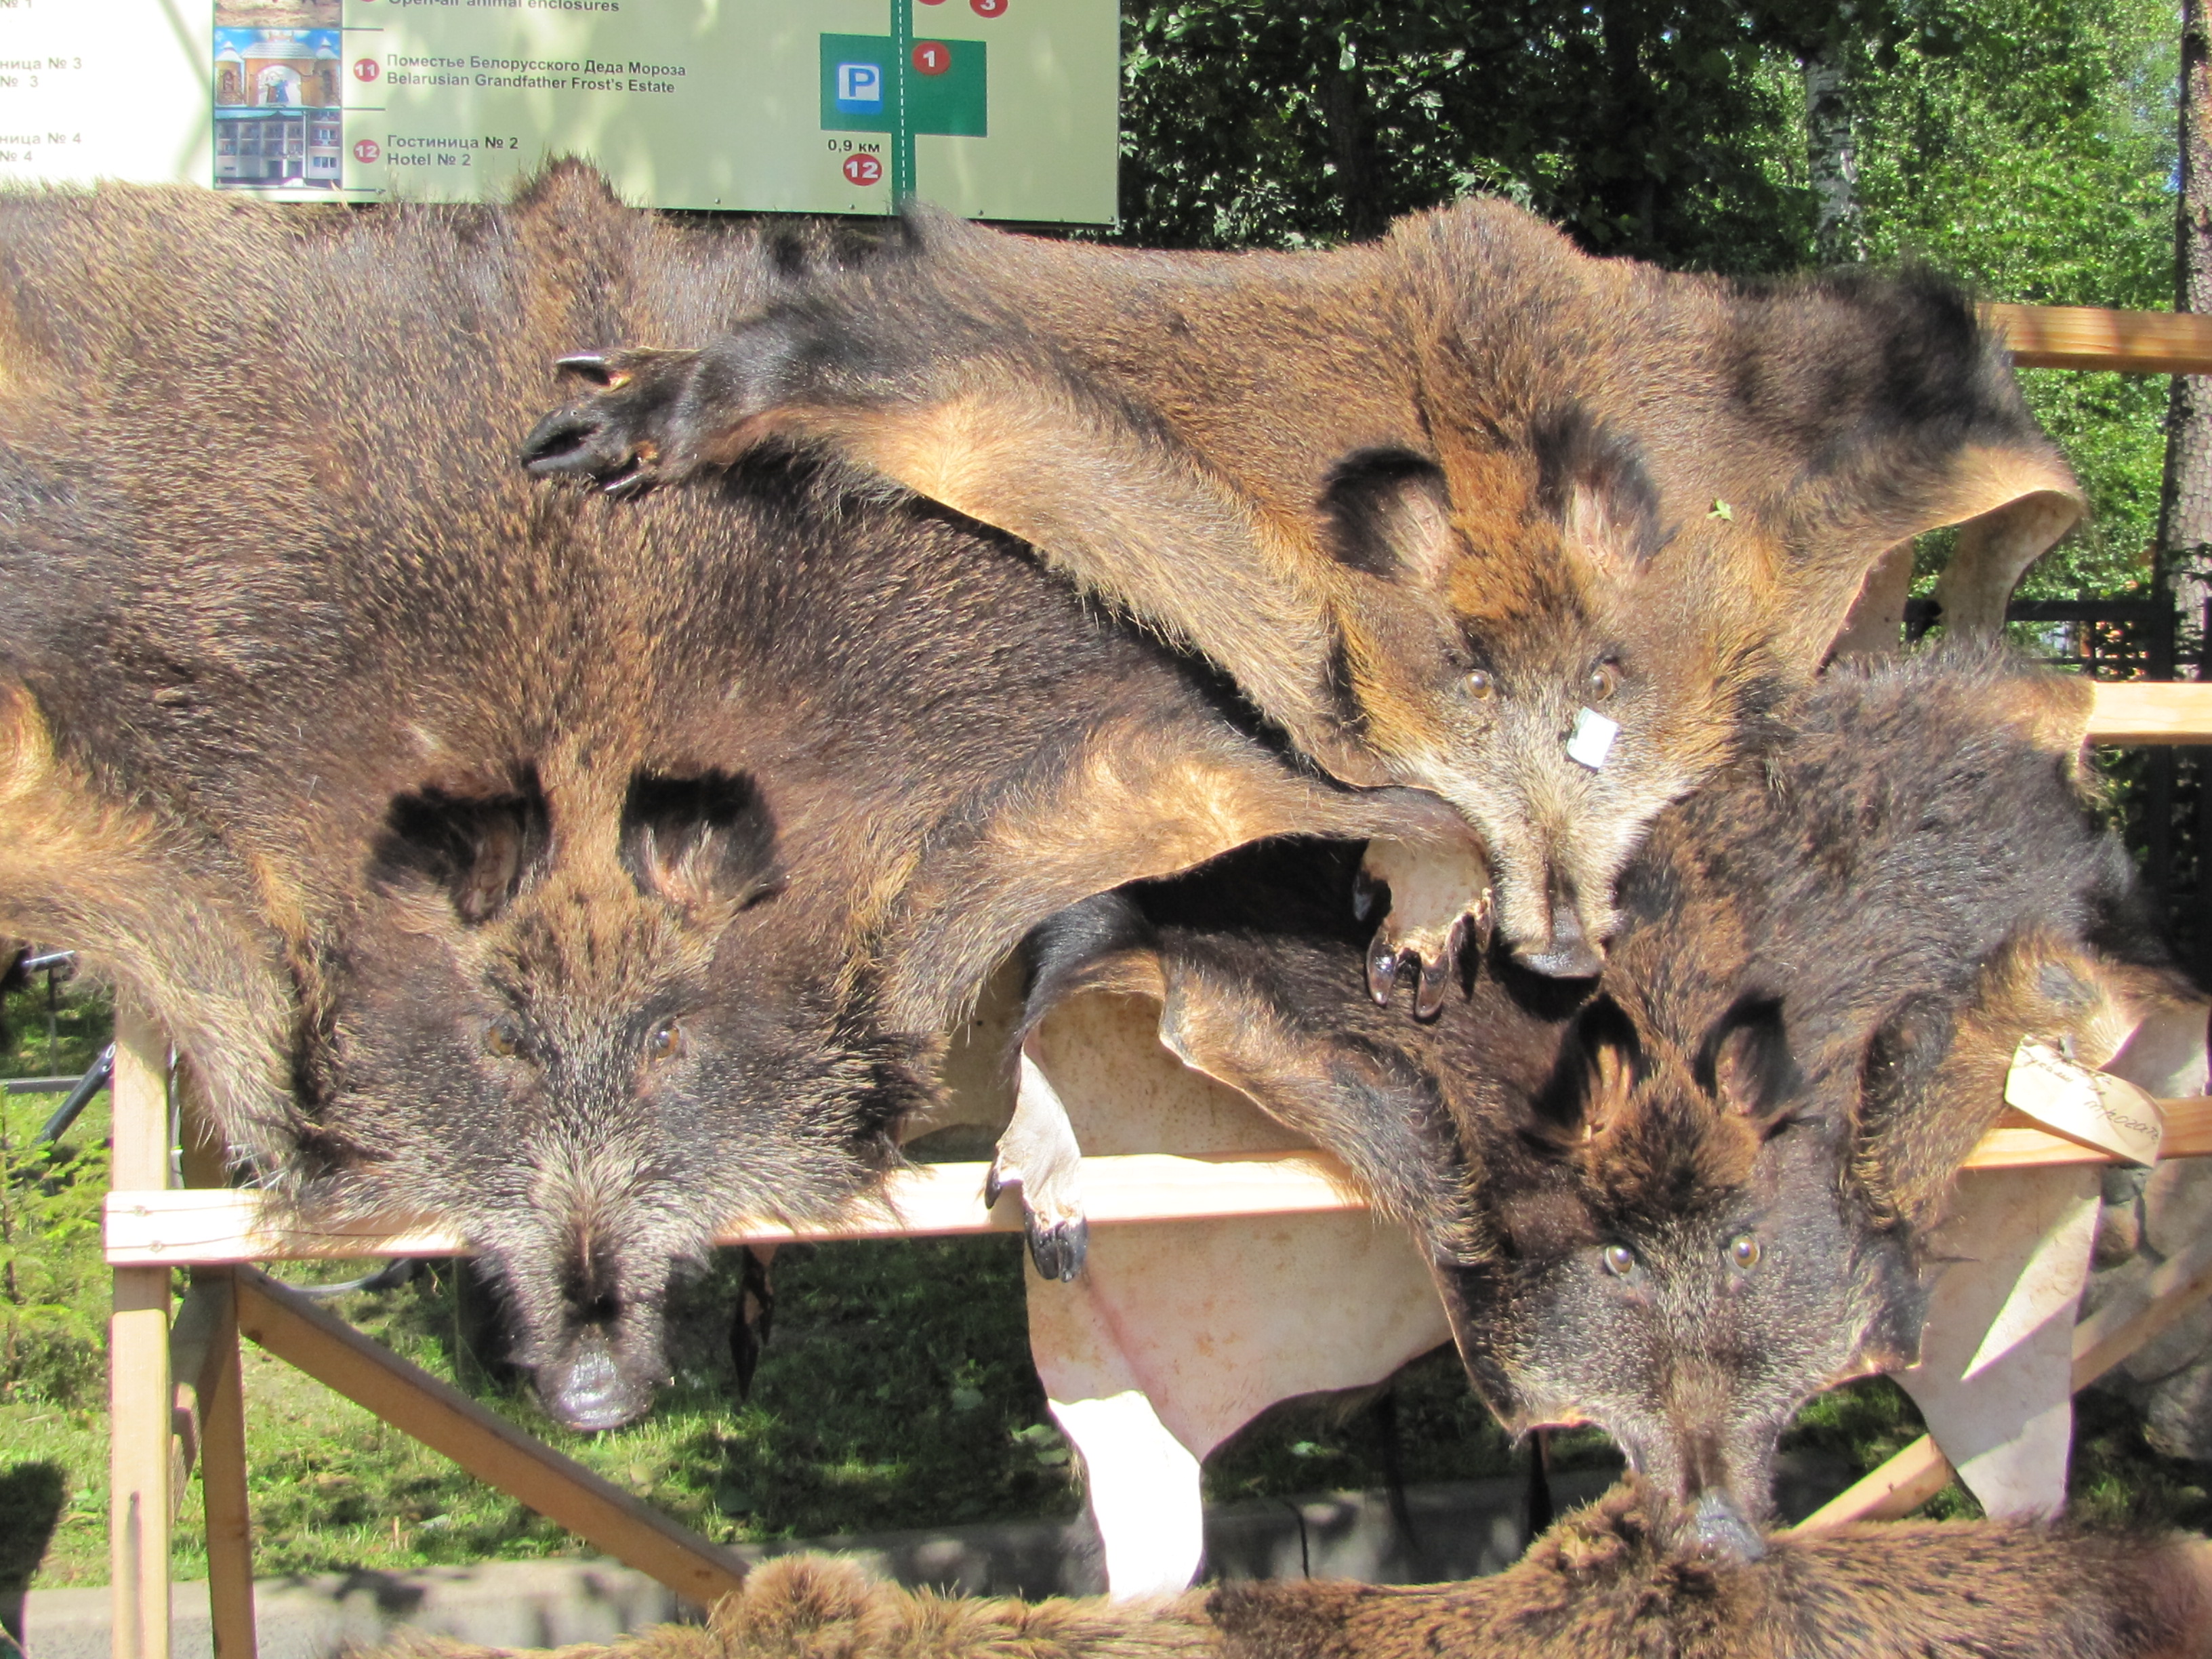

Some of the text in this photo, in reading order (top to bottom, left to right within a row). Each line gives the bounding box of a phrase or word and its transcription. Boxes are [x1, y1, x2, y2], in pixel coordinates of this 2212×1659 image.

[529, 0, 619, 12] enclosures
[48, 57, 67, 69] №
[73, 57, 82, 69] 3
[923, 50, 935, 67] 1
[354, 64, 375, 76] 11
[387, 54, 686, 77] Поместье Белорусского Деда Мороза
[30, 75, 39, 87] 3
[387, 72, 675, 93] Belarusian Grandfather Frost's Estate
[849, 68, 876, 97] P
[47, 132, 66, 144] №
[73, 132, 81, 144] 4
[387, 135, 518, 149] Гостиница № 2
[354, 145, 377, 158] 12
[827, 139, 880, 152] 0,9 км
[24, 150, 33, 162] 4
[387, 153, 471, 165] Hotel № 2
[846, 161, 878, 178] 12
